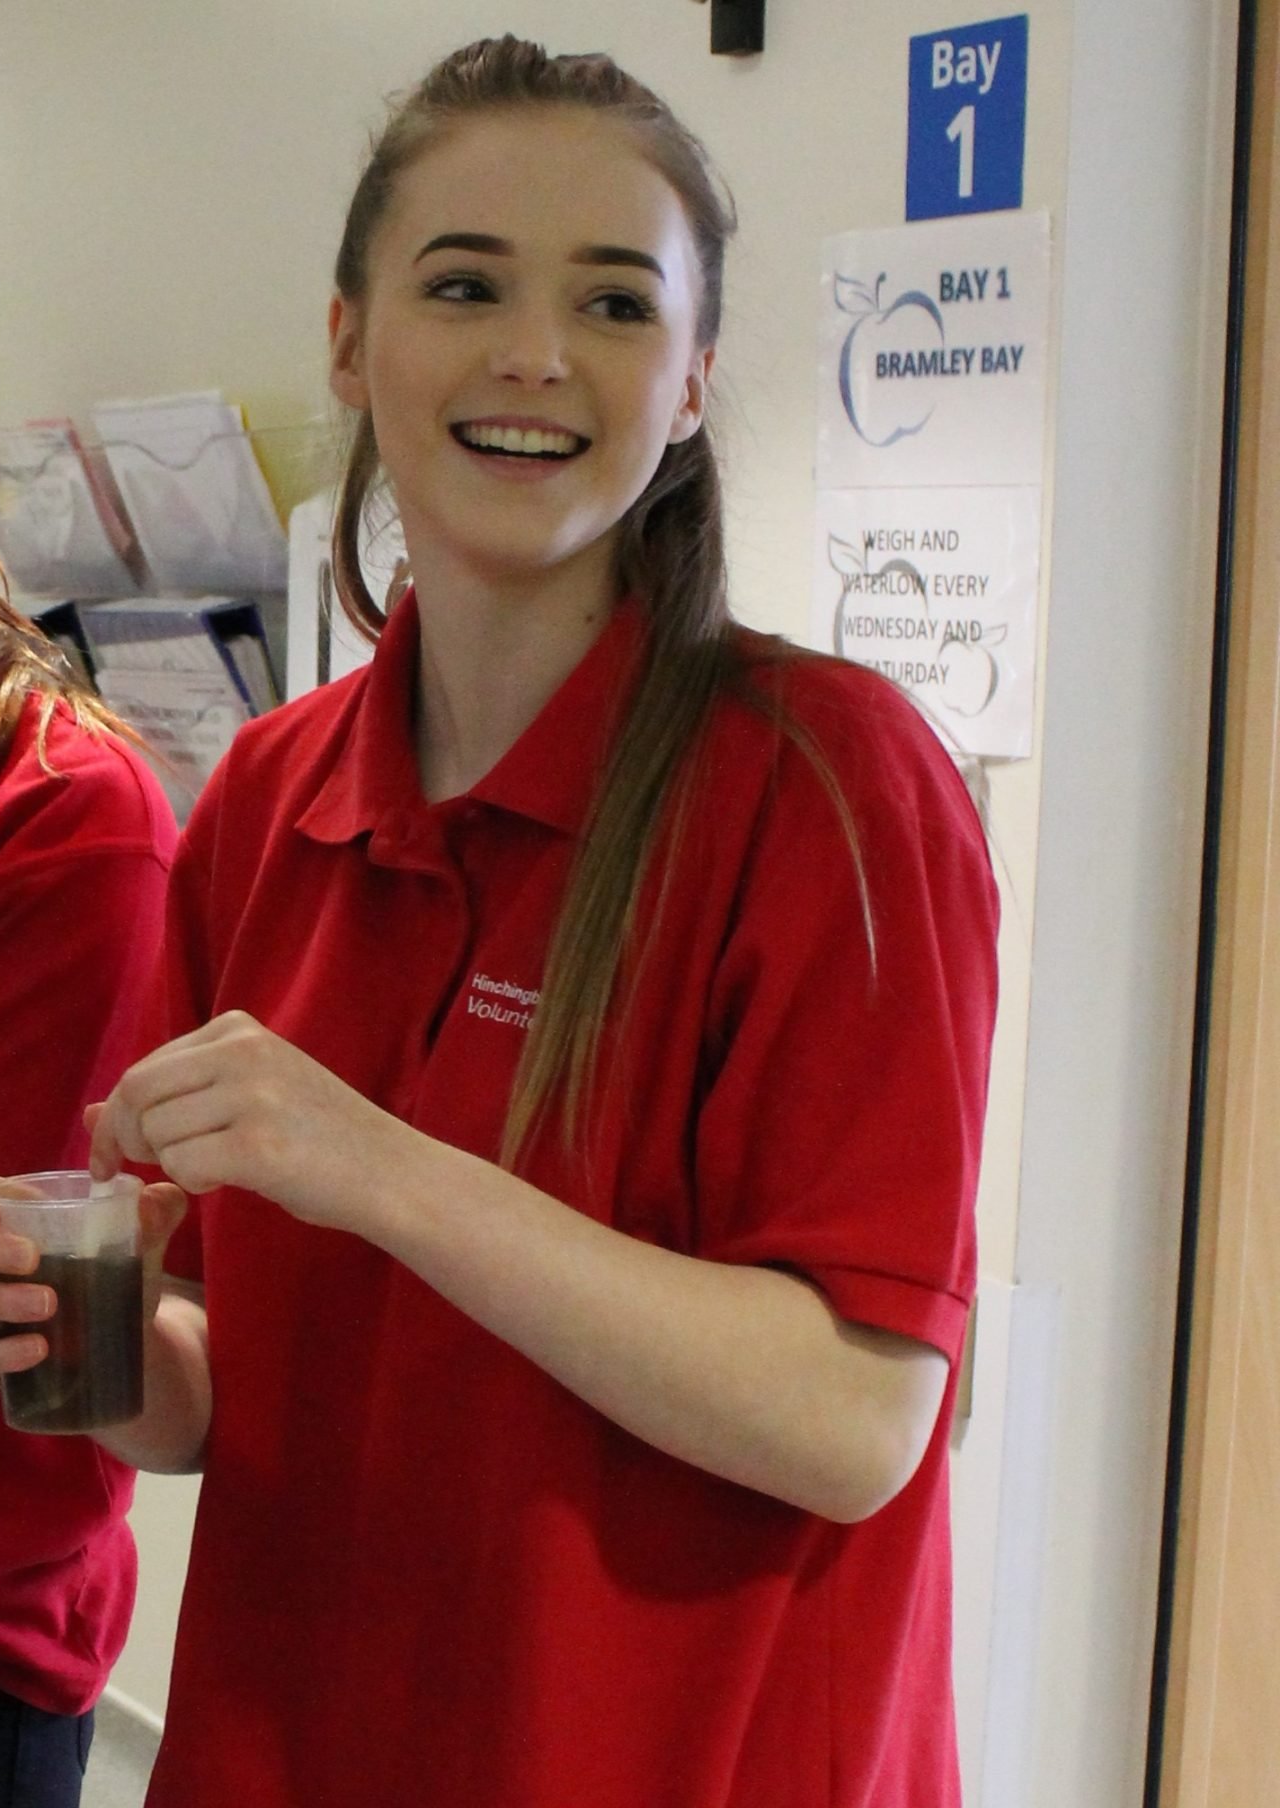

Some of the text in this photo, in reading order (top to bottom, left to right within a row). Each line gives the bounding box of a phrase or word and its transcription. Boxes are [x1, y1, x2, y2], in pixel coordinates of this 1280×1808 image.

[932, 40, 1002, 95] Bay
[945, 105, 976, 199] 1
[938, 266, 1011, 303] BAY 1
[875, 345, 1025, 379] BRAMLEY BAY
[862, 529, 960, 552] WEIGH AND
[842, 572, 989, 597] WATERLOW EVERY
[843, 615, 983, 642] WEDNESDAY AND
